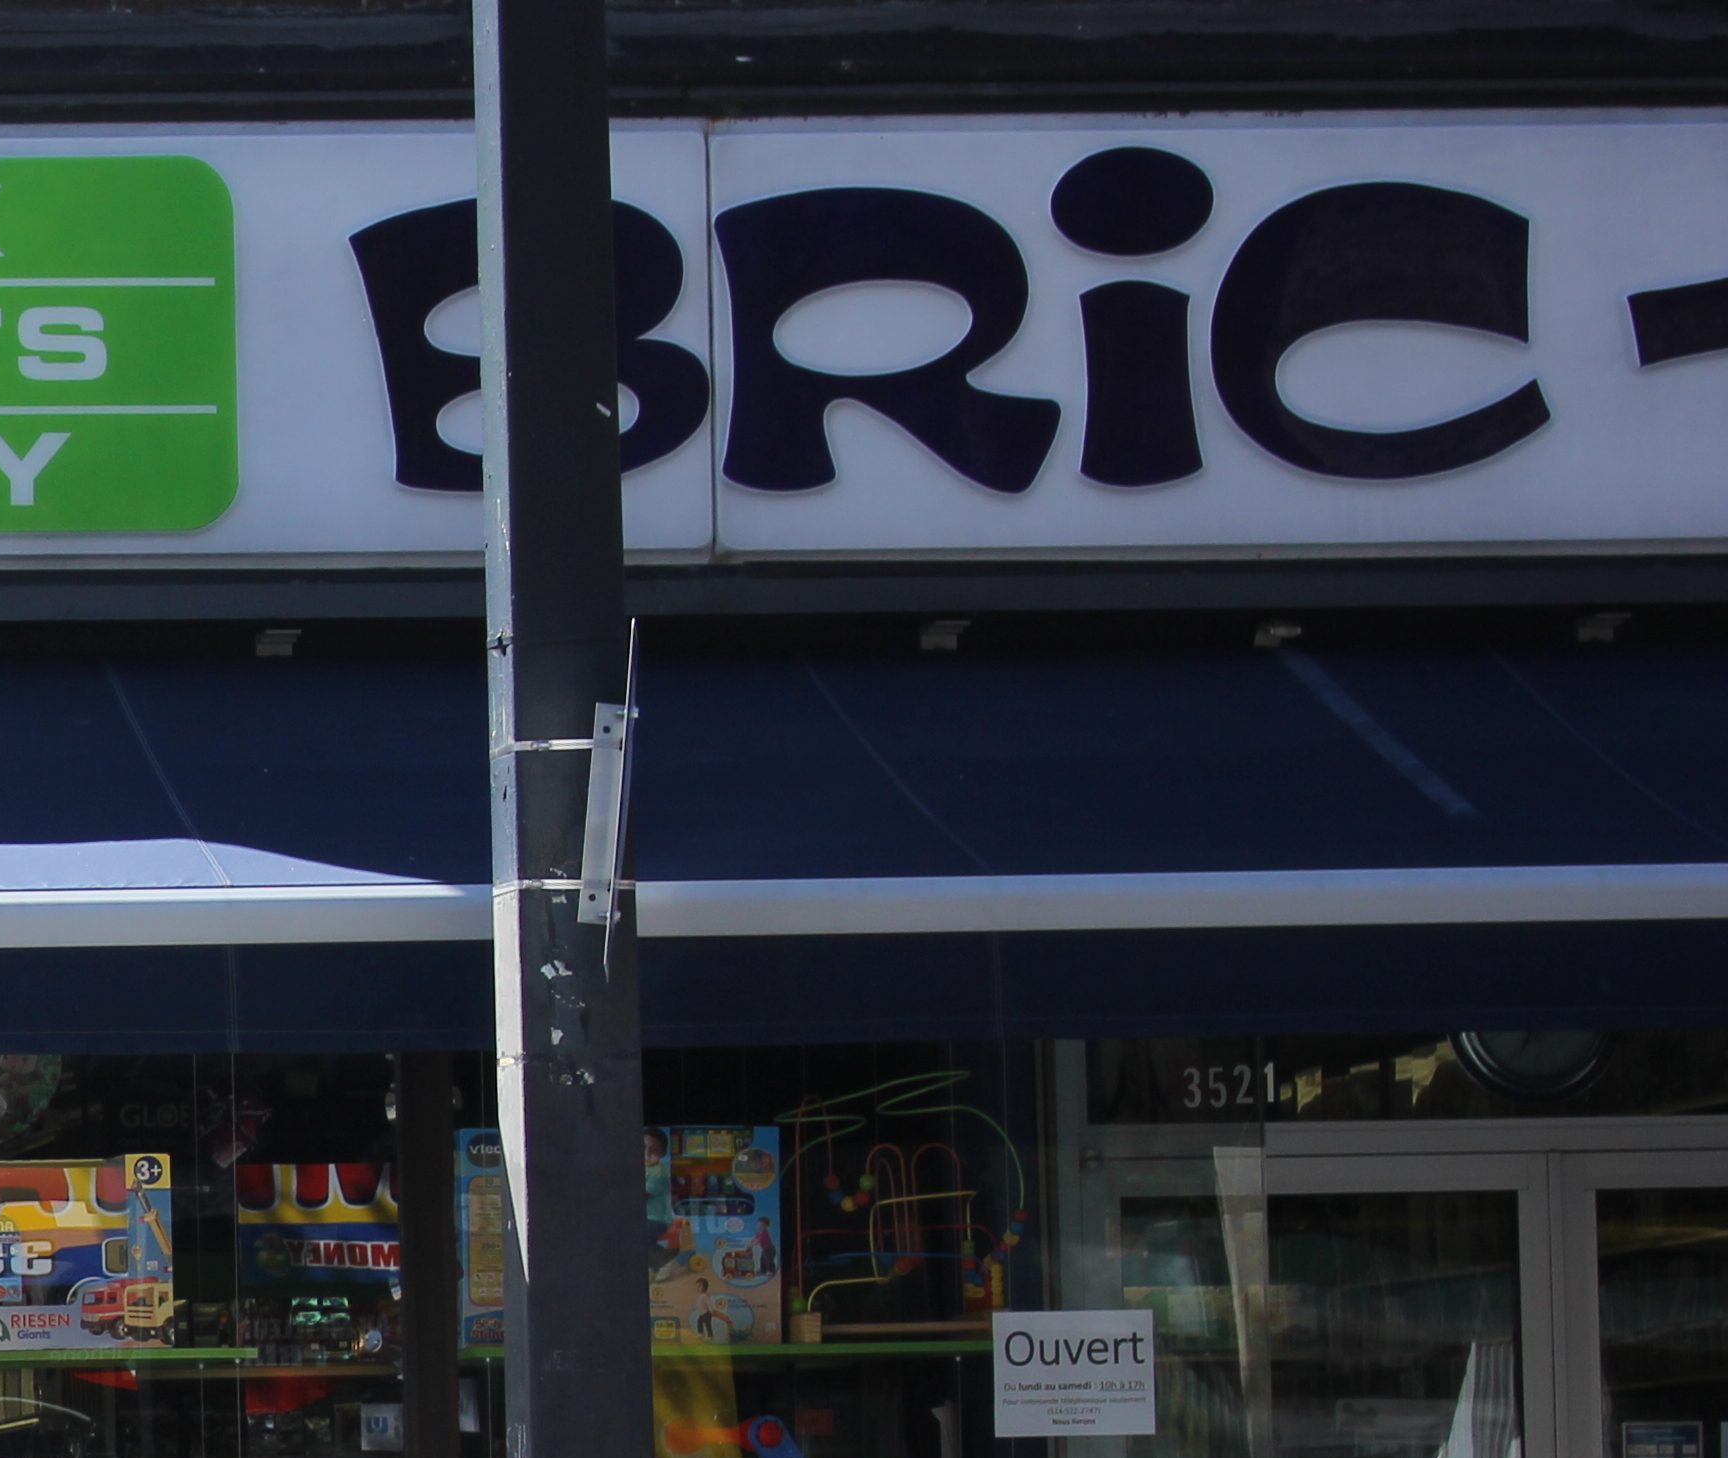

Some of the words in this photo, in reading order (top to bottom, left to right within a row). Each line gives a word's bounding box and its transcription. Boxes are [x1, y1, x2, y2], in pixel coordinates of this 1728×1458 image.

[1182, 1060, 1275, 1109] 3521
[9, 1313, 71, 1329] RIESEN
[17, 1329, 51, 1340] Giants
[1004, 1330, 1146, 1367] Ouvert
[1003, 1383, 1017, 1392] Du
[1018, 1381, 1042, 1392] lundi
[1057, 1381, 1092, 1392] samedi
[1099, 1381, 1118, 1392] 10h
[1127, 1380, 1146, 1391] 17h
